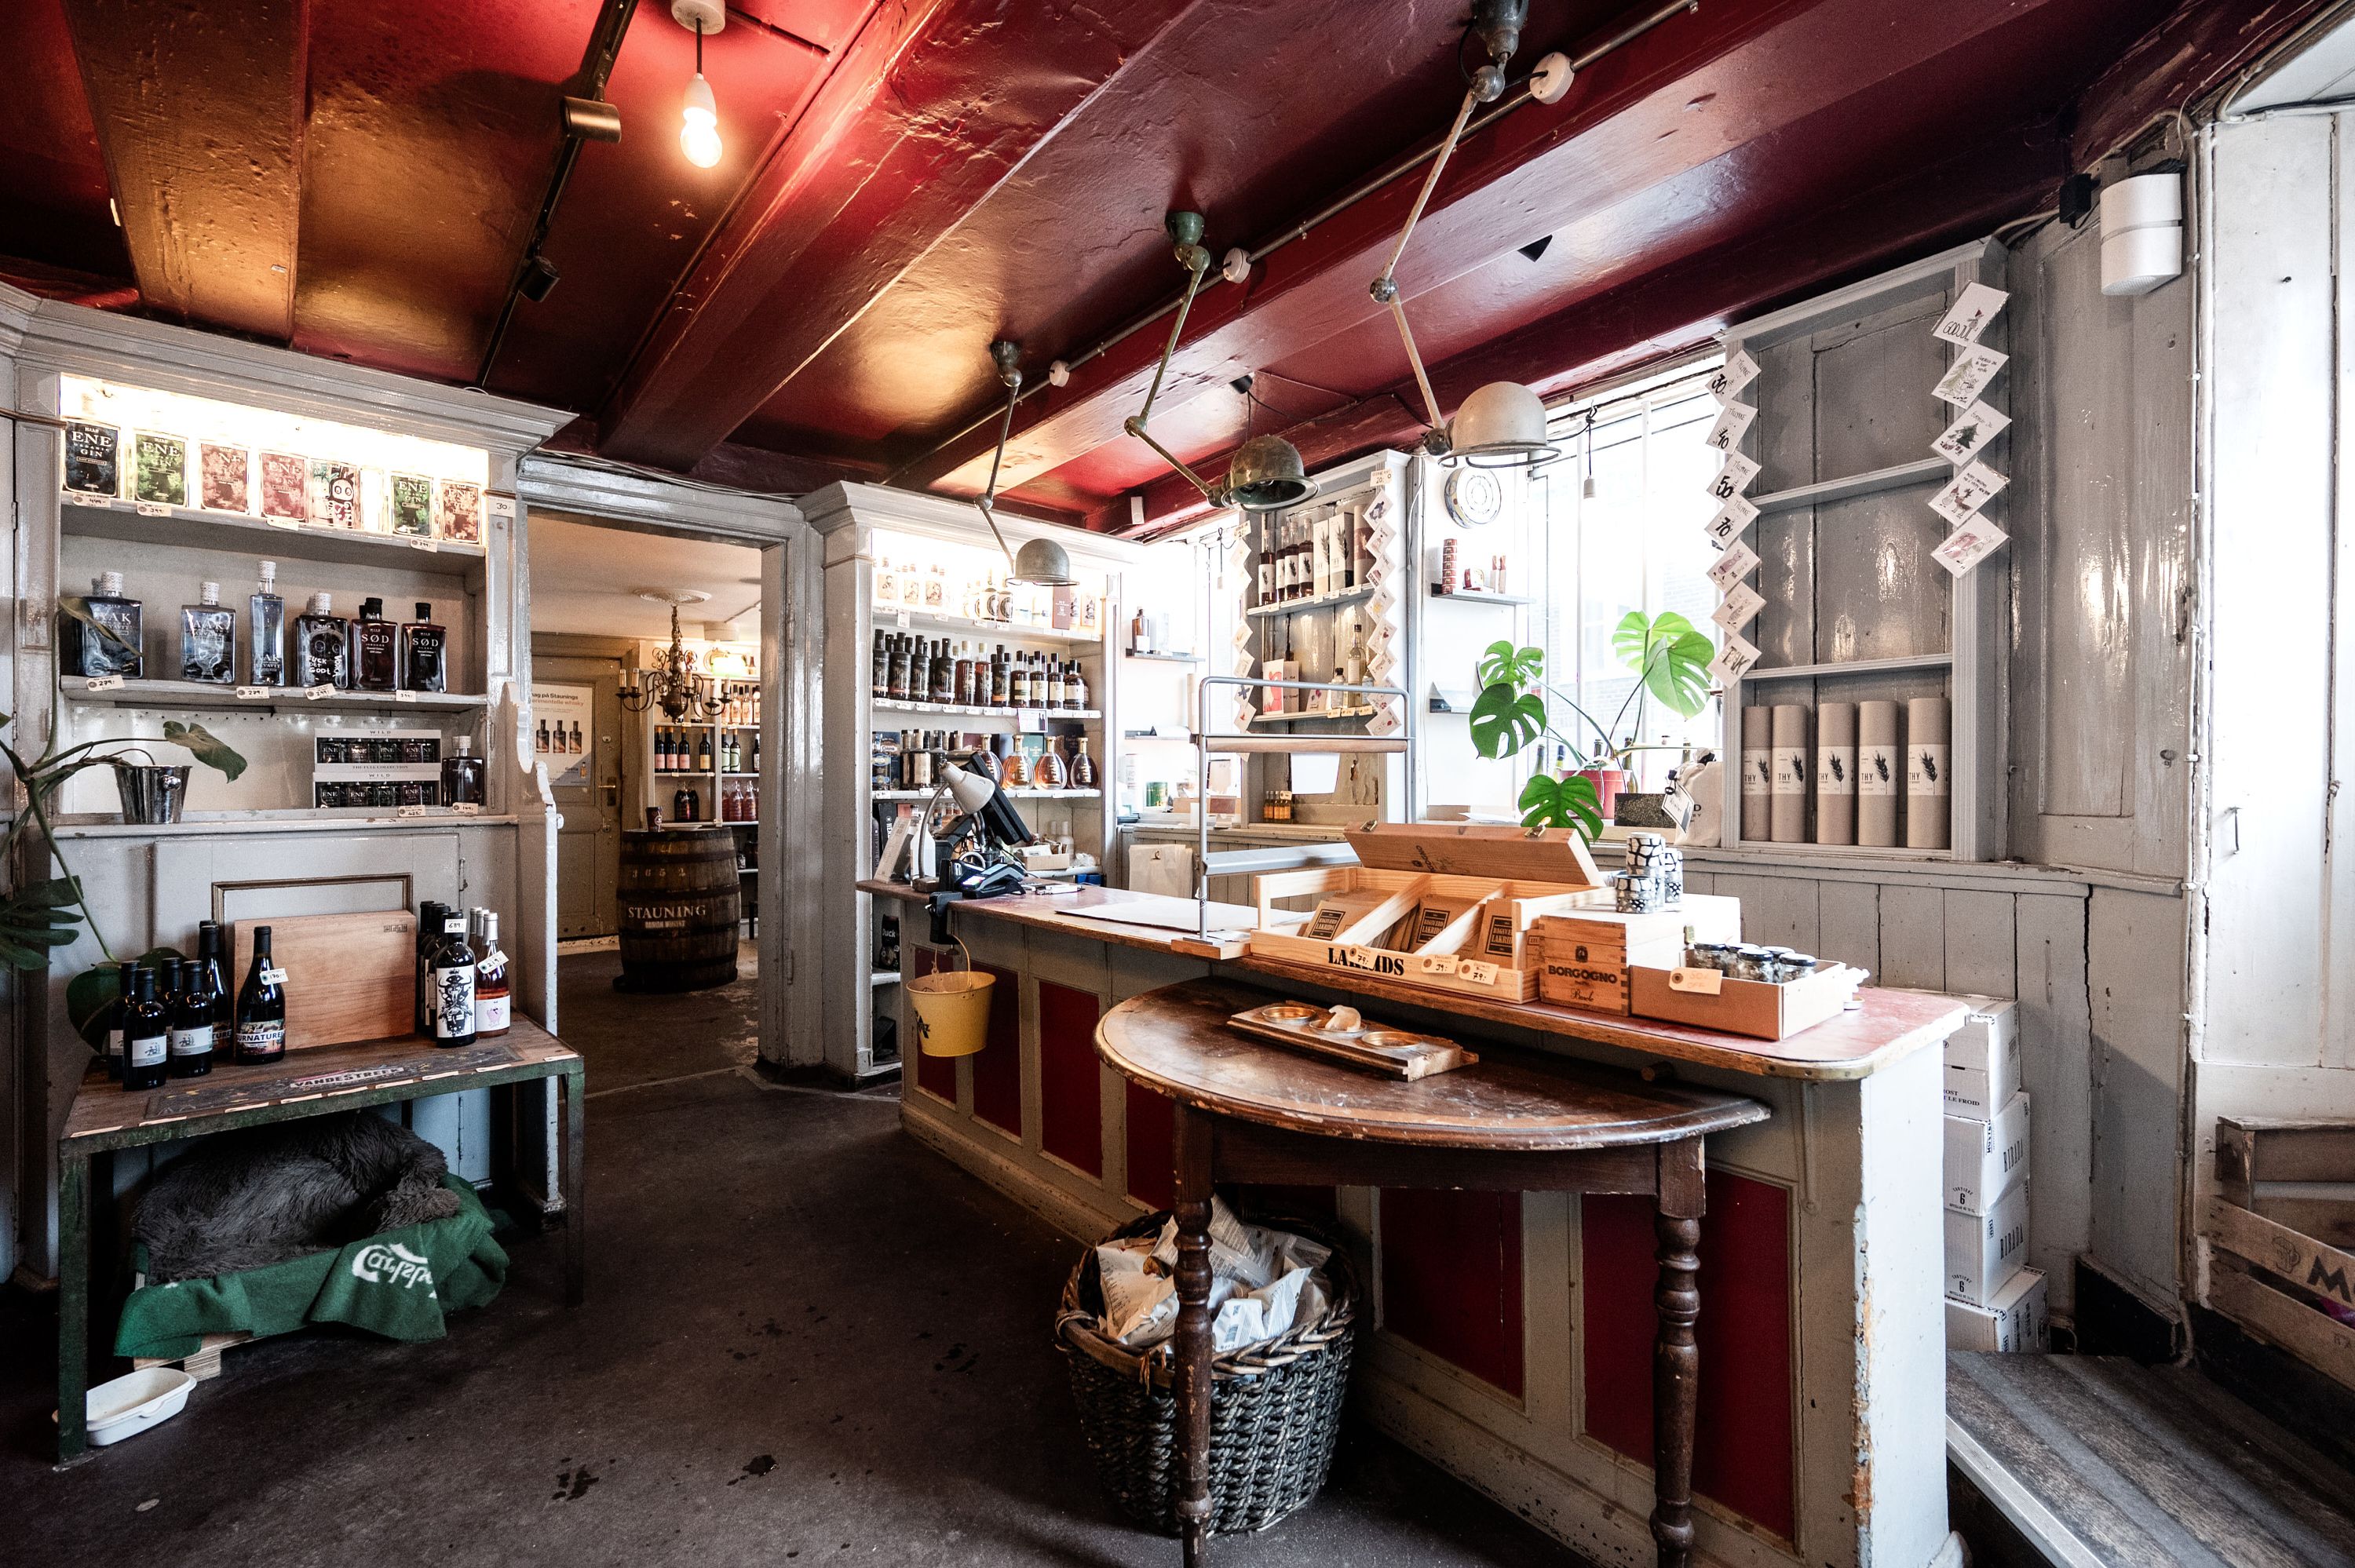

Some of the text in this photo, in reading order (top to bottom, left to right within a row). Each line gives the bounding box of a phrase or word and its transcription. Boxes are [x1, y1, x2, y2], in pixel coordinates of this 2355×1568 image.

[71, 431, 112, 447] ENE
[80, 449, 103, 458] GIN
[142, 441, 180, 456] ENE
[268, 461, 301, 474] ENE
[399, 480, 427, 494] ENE
[361, 634, 389, 644] SØD
[412, 638, 439, 647] SØD
[308, 655, 327, 665] FUCK
[1861, 772, 1873, 781] THY
[628, 905, 706, 919] STAUNING
[1328, 946, 1404, 975] LAIDS
[1548, 965, 1618, 984] BORGOGNO
[295, 1068, 400, 1087] VANDESTREEK
[1959, 1192, 1966, 1205] 6
[2000, 1223, 2024, 1260] RIBADA
[1959, 1280, 1965, 1293] 6
[2306, 1255, 2355, 1304] M
